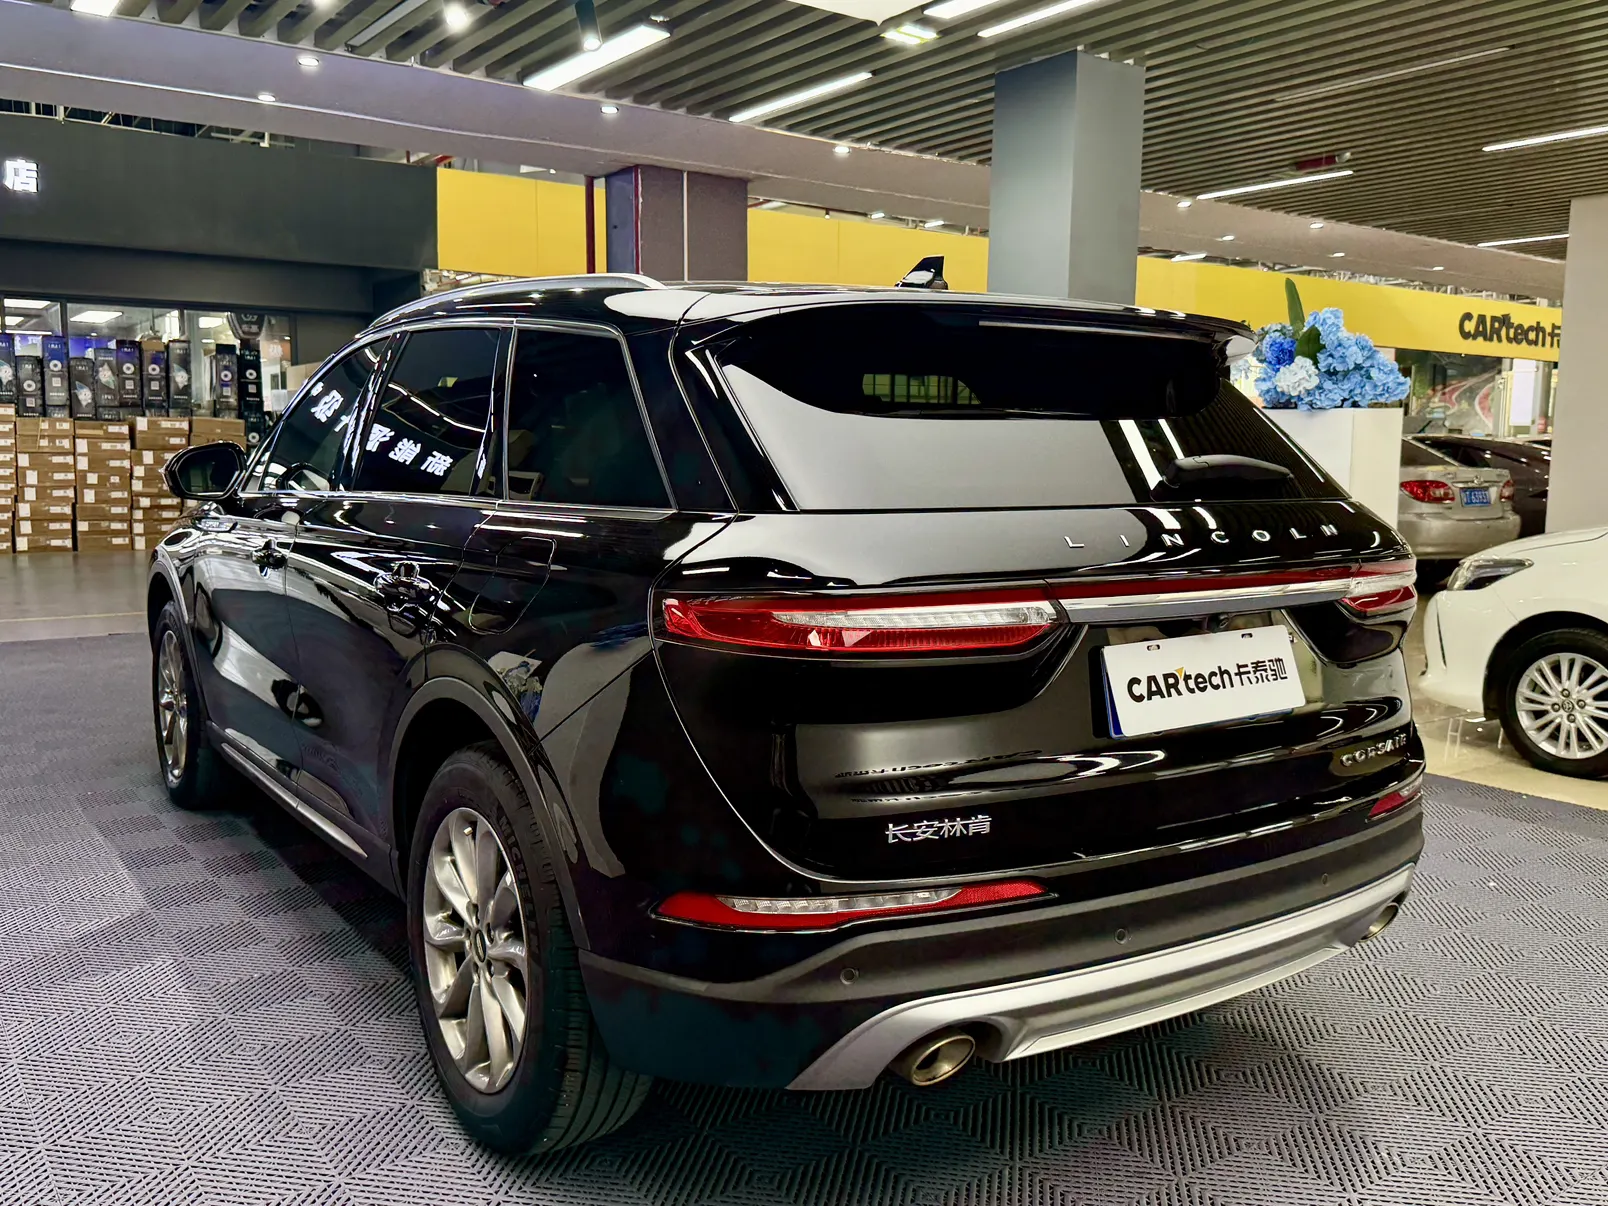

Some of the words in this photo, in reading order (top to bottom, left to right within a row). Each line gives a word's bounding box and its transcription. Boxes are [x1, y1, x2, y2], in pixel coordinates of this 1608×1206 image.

[4, 158, 39, 193] 店
[1064, 524, 1339, 548] LINCOLN
[1340, 733, 1407, 767] CORSAIR
[885, 814, 993, 844] 长安林肯
